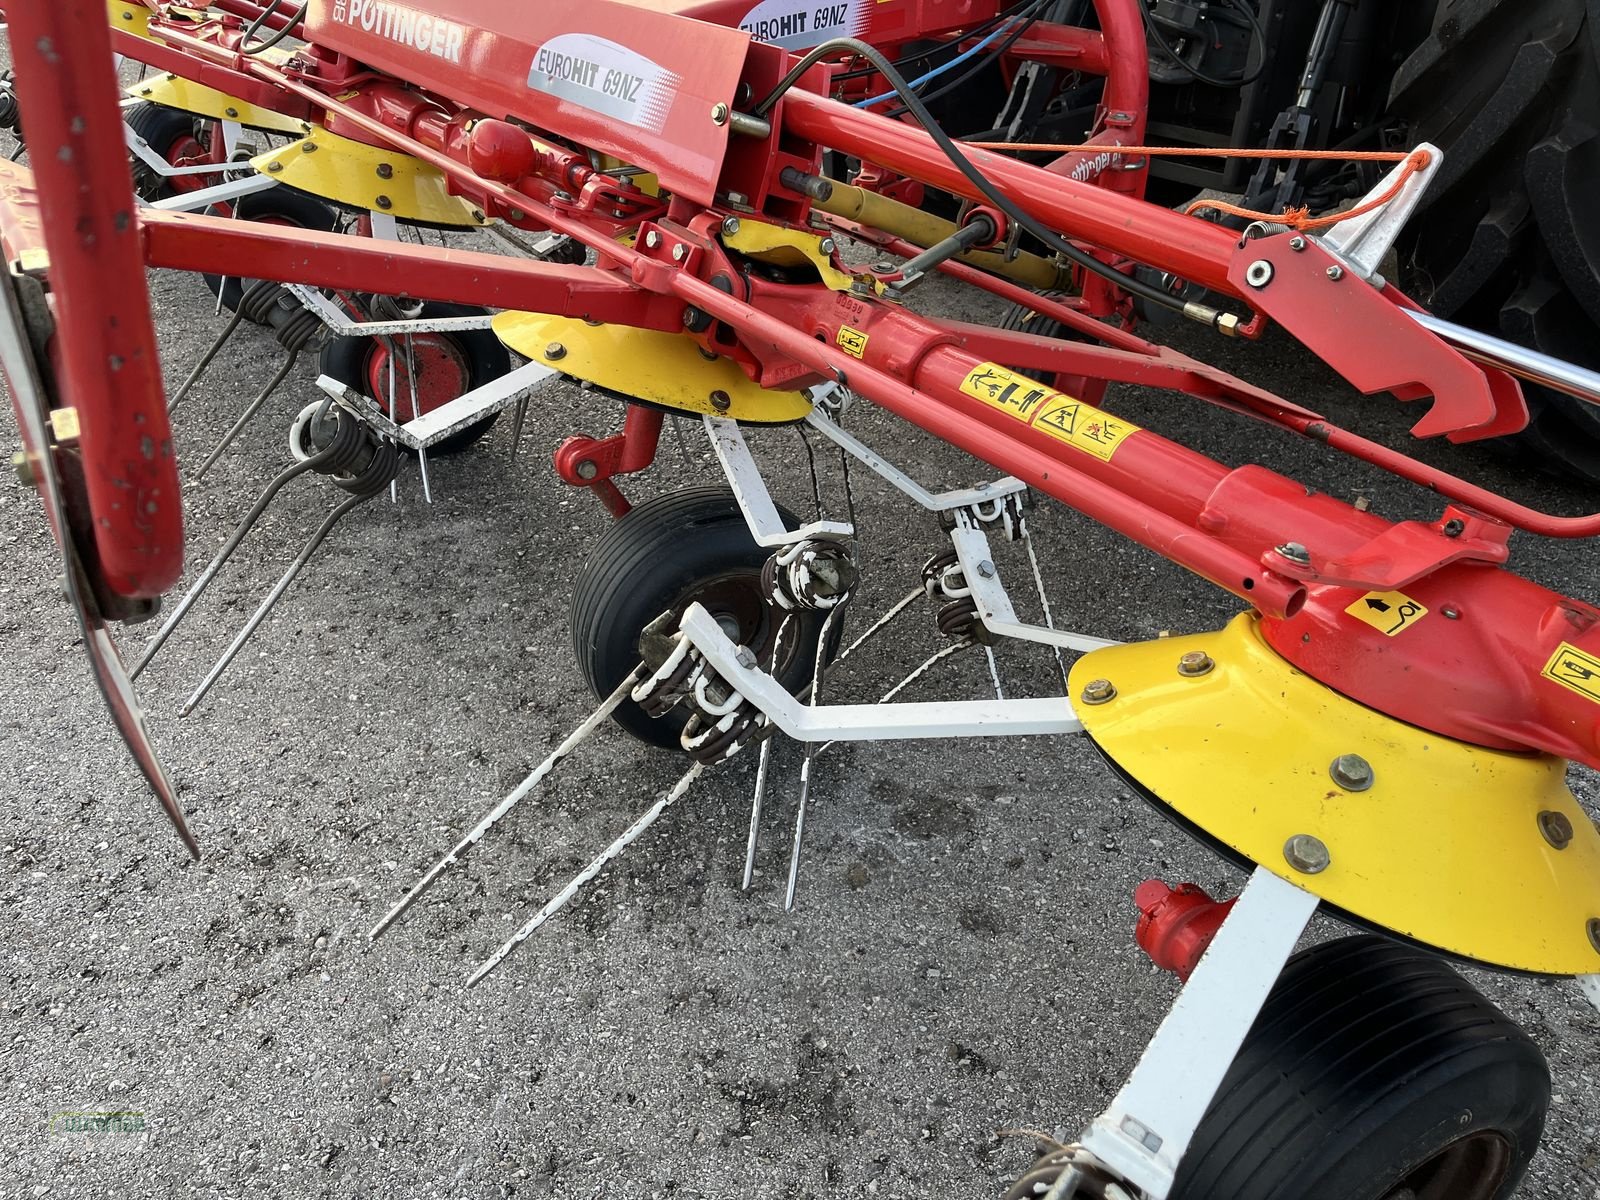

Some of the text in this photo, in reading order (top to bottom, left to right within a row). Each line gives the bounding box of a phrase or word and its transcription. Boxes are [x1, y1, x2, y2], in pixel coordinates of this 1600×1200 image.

[813, 3, 848, 30] 69NZ
[537, 49, 644, 103] EUROHIT 69NZ
